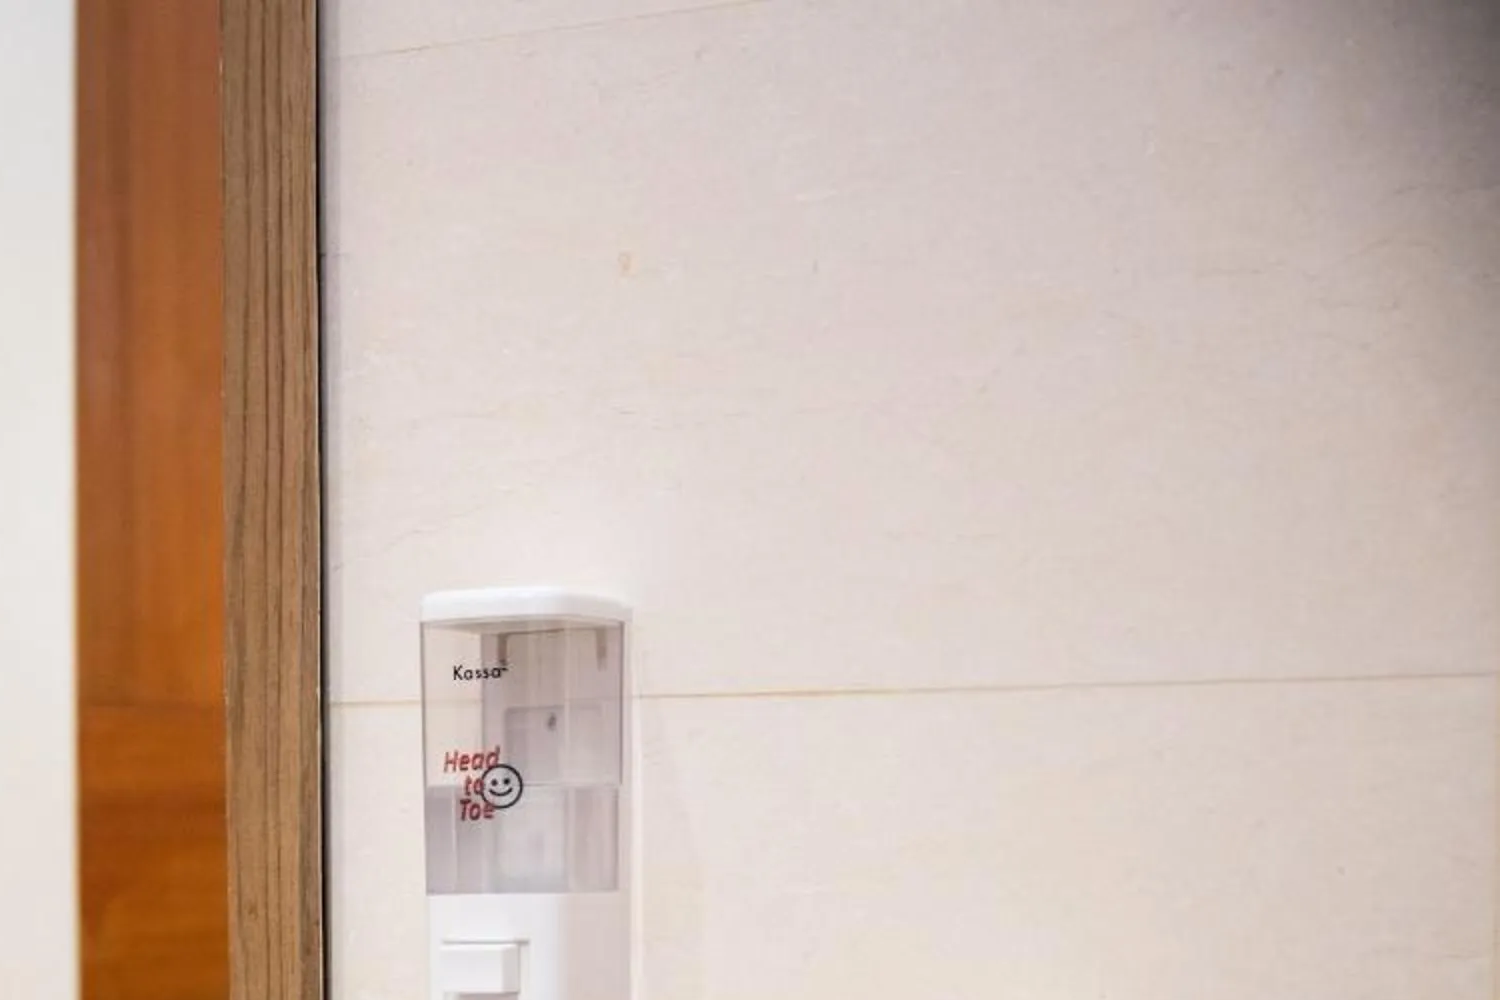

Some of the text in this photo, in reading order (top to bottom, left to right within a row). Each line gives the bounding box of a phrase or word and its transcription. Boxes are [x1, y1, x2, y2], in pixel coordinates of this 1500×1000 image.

[452, 664, 503, 681] Kassa
[443, 745, 501, 773] Head
[464, 775, 485, 797] to
[459, 798, 495, 822] Toe
